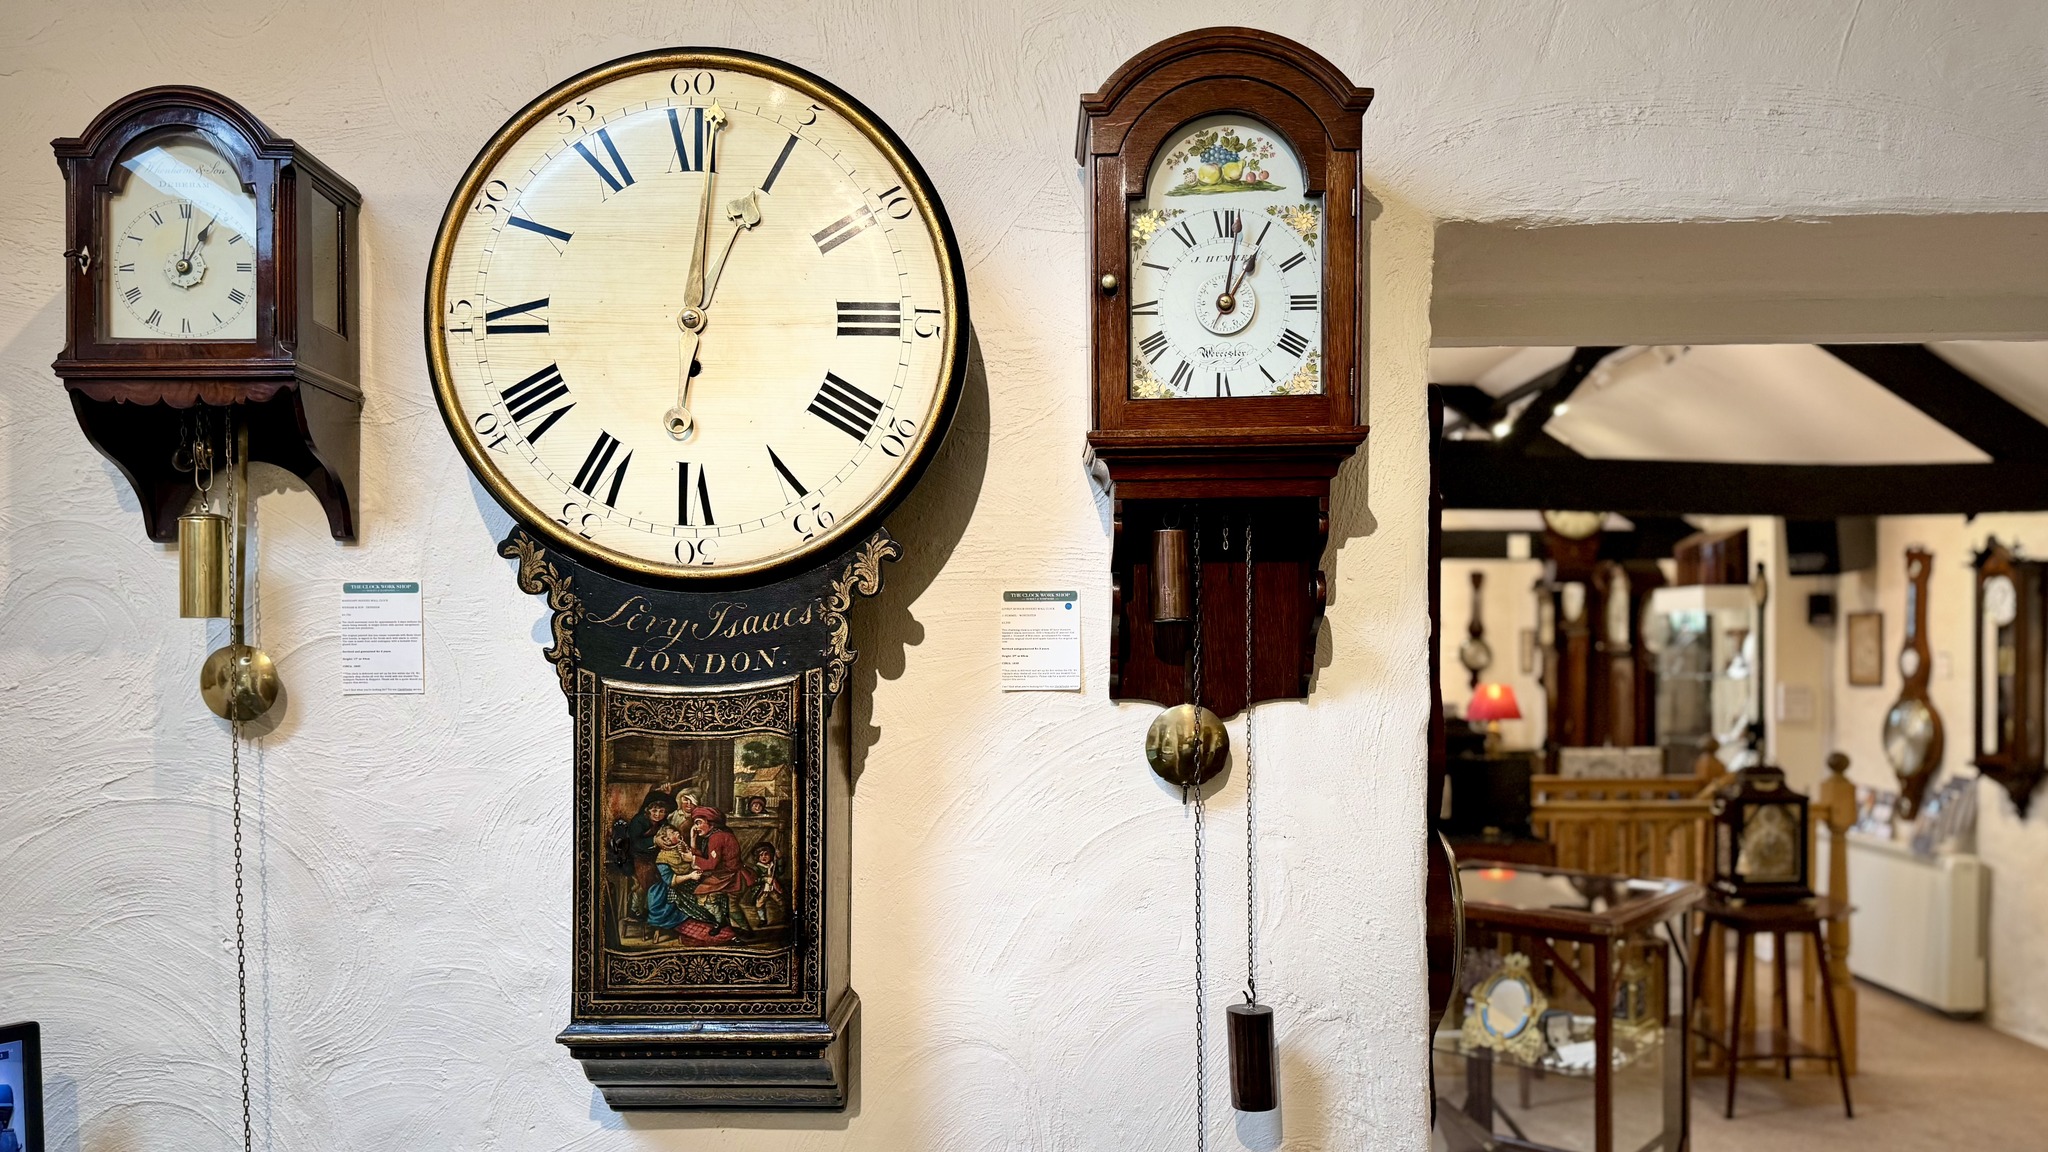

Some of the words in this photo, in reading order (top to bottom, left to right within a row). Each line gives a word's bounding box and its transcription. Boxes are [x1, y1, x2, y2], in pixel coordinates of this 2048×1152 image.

[670, 71, 716, 97] 60
[557, 97, 595, 134] 55
[795, 103, 824, 126] 5
[665, 107, 720, 174] XII
[206, 161, 227, 175] Son
[572, 127, 638, 201] XI
[759, 134, 800, 194] I
[475, 180, 509, 225] 50
[877, 184, 914, 220] 10
[506, 202, 574, 256] X
[810, 204, 877, 256] II
[1171, 220, 1197, 252] XI
[1213, 210, 1235, 239] XII
[1256, 221, 1271, 246] I
[1142, 257, 1169, 278] X
[1206, 254, 1257, 263] HUMME
[1279, 252, 1306, 273] II
[485, 296, 550, 336] IX
[836, 300, 901, 339] III
[1131, 300, 1158, 315] IX
[1290, 295, 1317, 310] III
[449, 299, 474, 345] 45
[914, 305, 942, 340] 15
[1277, 328, 1309, 358] IIII
[1169, 359, 1195, 392] VII
[1216, 372, 1231, 397] VI
[1258, 363, 1276, 388] V
[805, 370, 886, 446] IIII
[474, 412, 509, 455] 40
[880, 418, 917, 458] 20
[569, 428, 634, 510] VII
[765, 444, 812, 507] V
[676, 462, 716, 526] VI
[556, 501, 603, 539] 35
[793, 502, 835, 542] 25
[674, 538, 720, 566] 30
[692, 601, 812, 641] Isaacs
